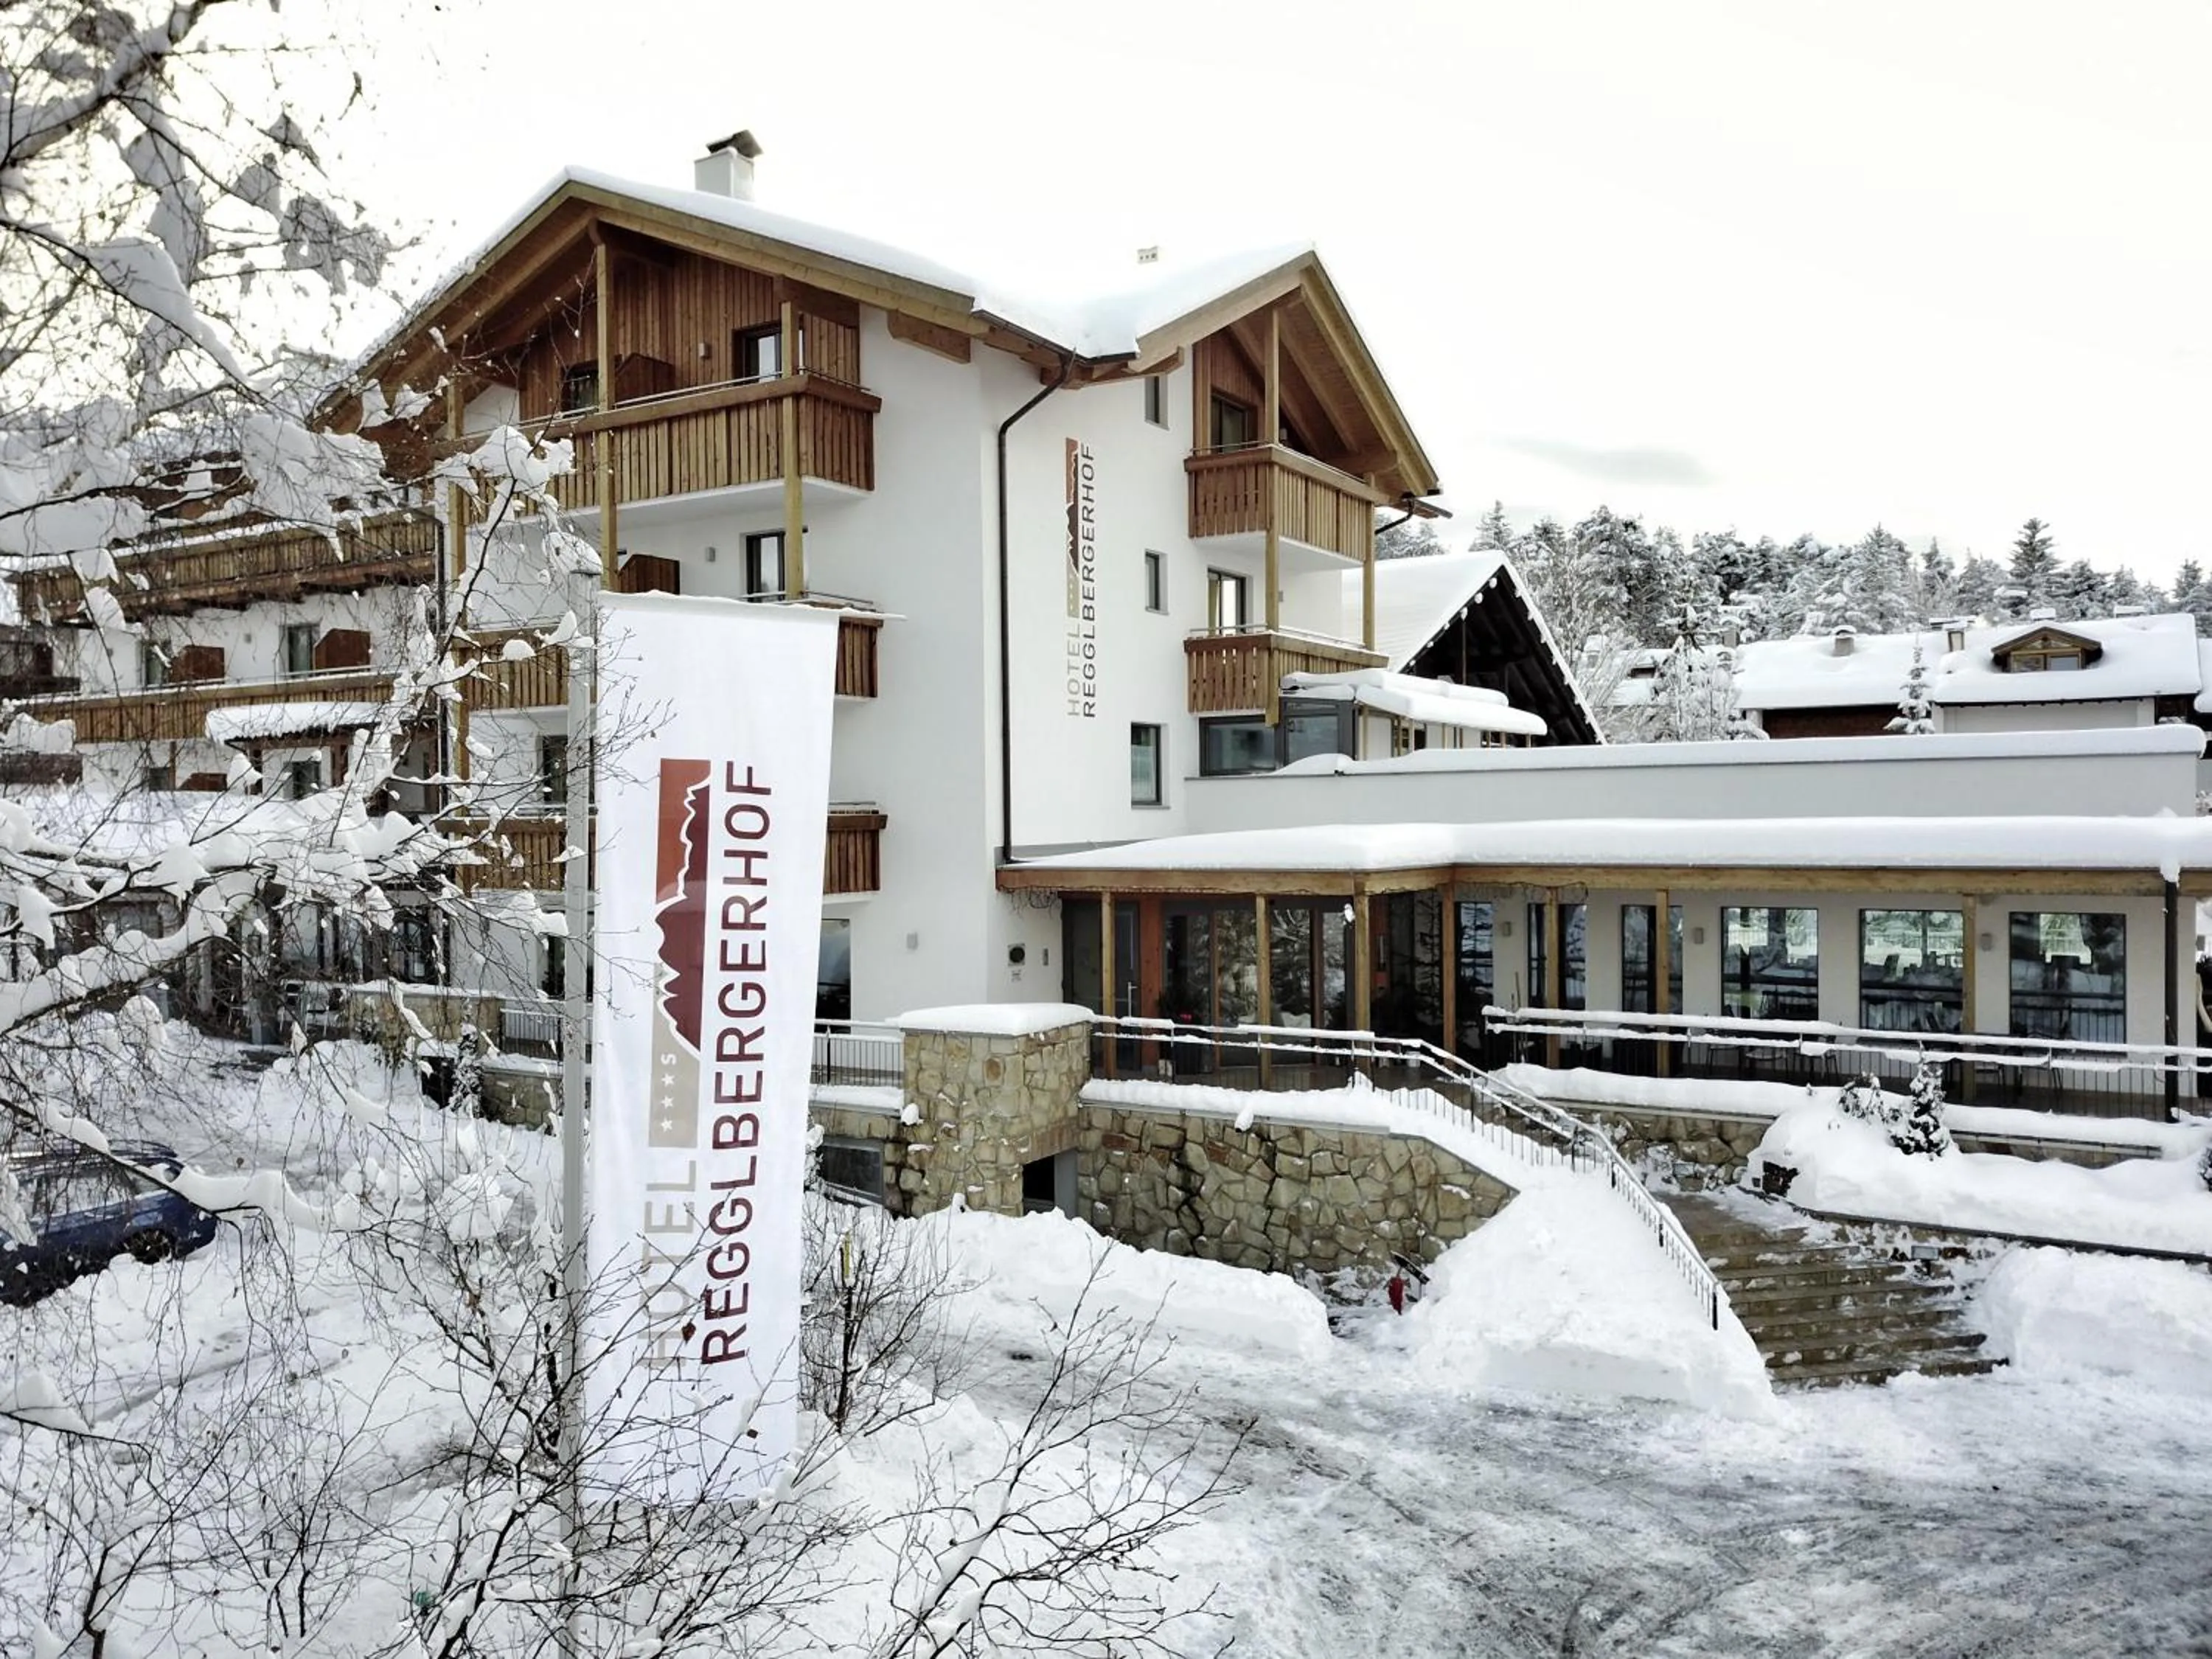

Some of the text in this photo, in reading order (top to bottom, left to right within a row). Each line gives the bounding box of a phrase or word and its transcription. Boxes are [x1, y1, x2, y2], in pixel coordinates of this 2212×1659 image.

[1067, 624, 1080, 716] HOTEL
[1081, 442, 1096, 717] REGGLBERGERHOF
[701, 760, 771, 1364] REGGLBERGERHOF
[636, 1160, 696, 1368] HOTEL
